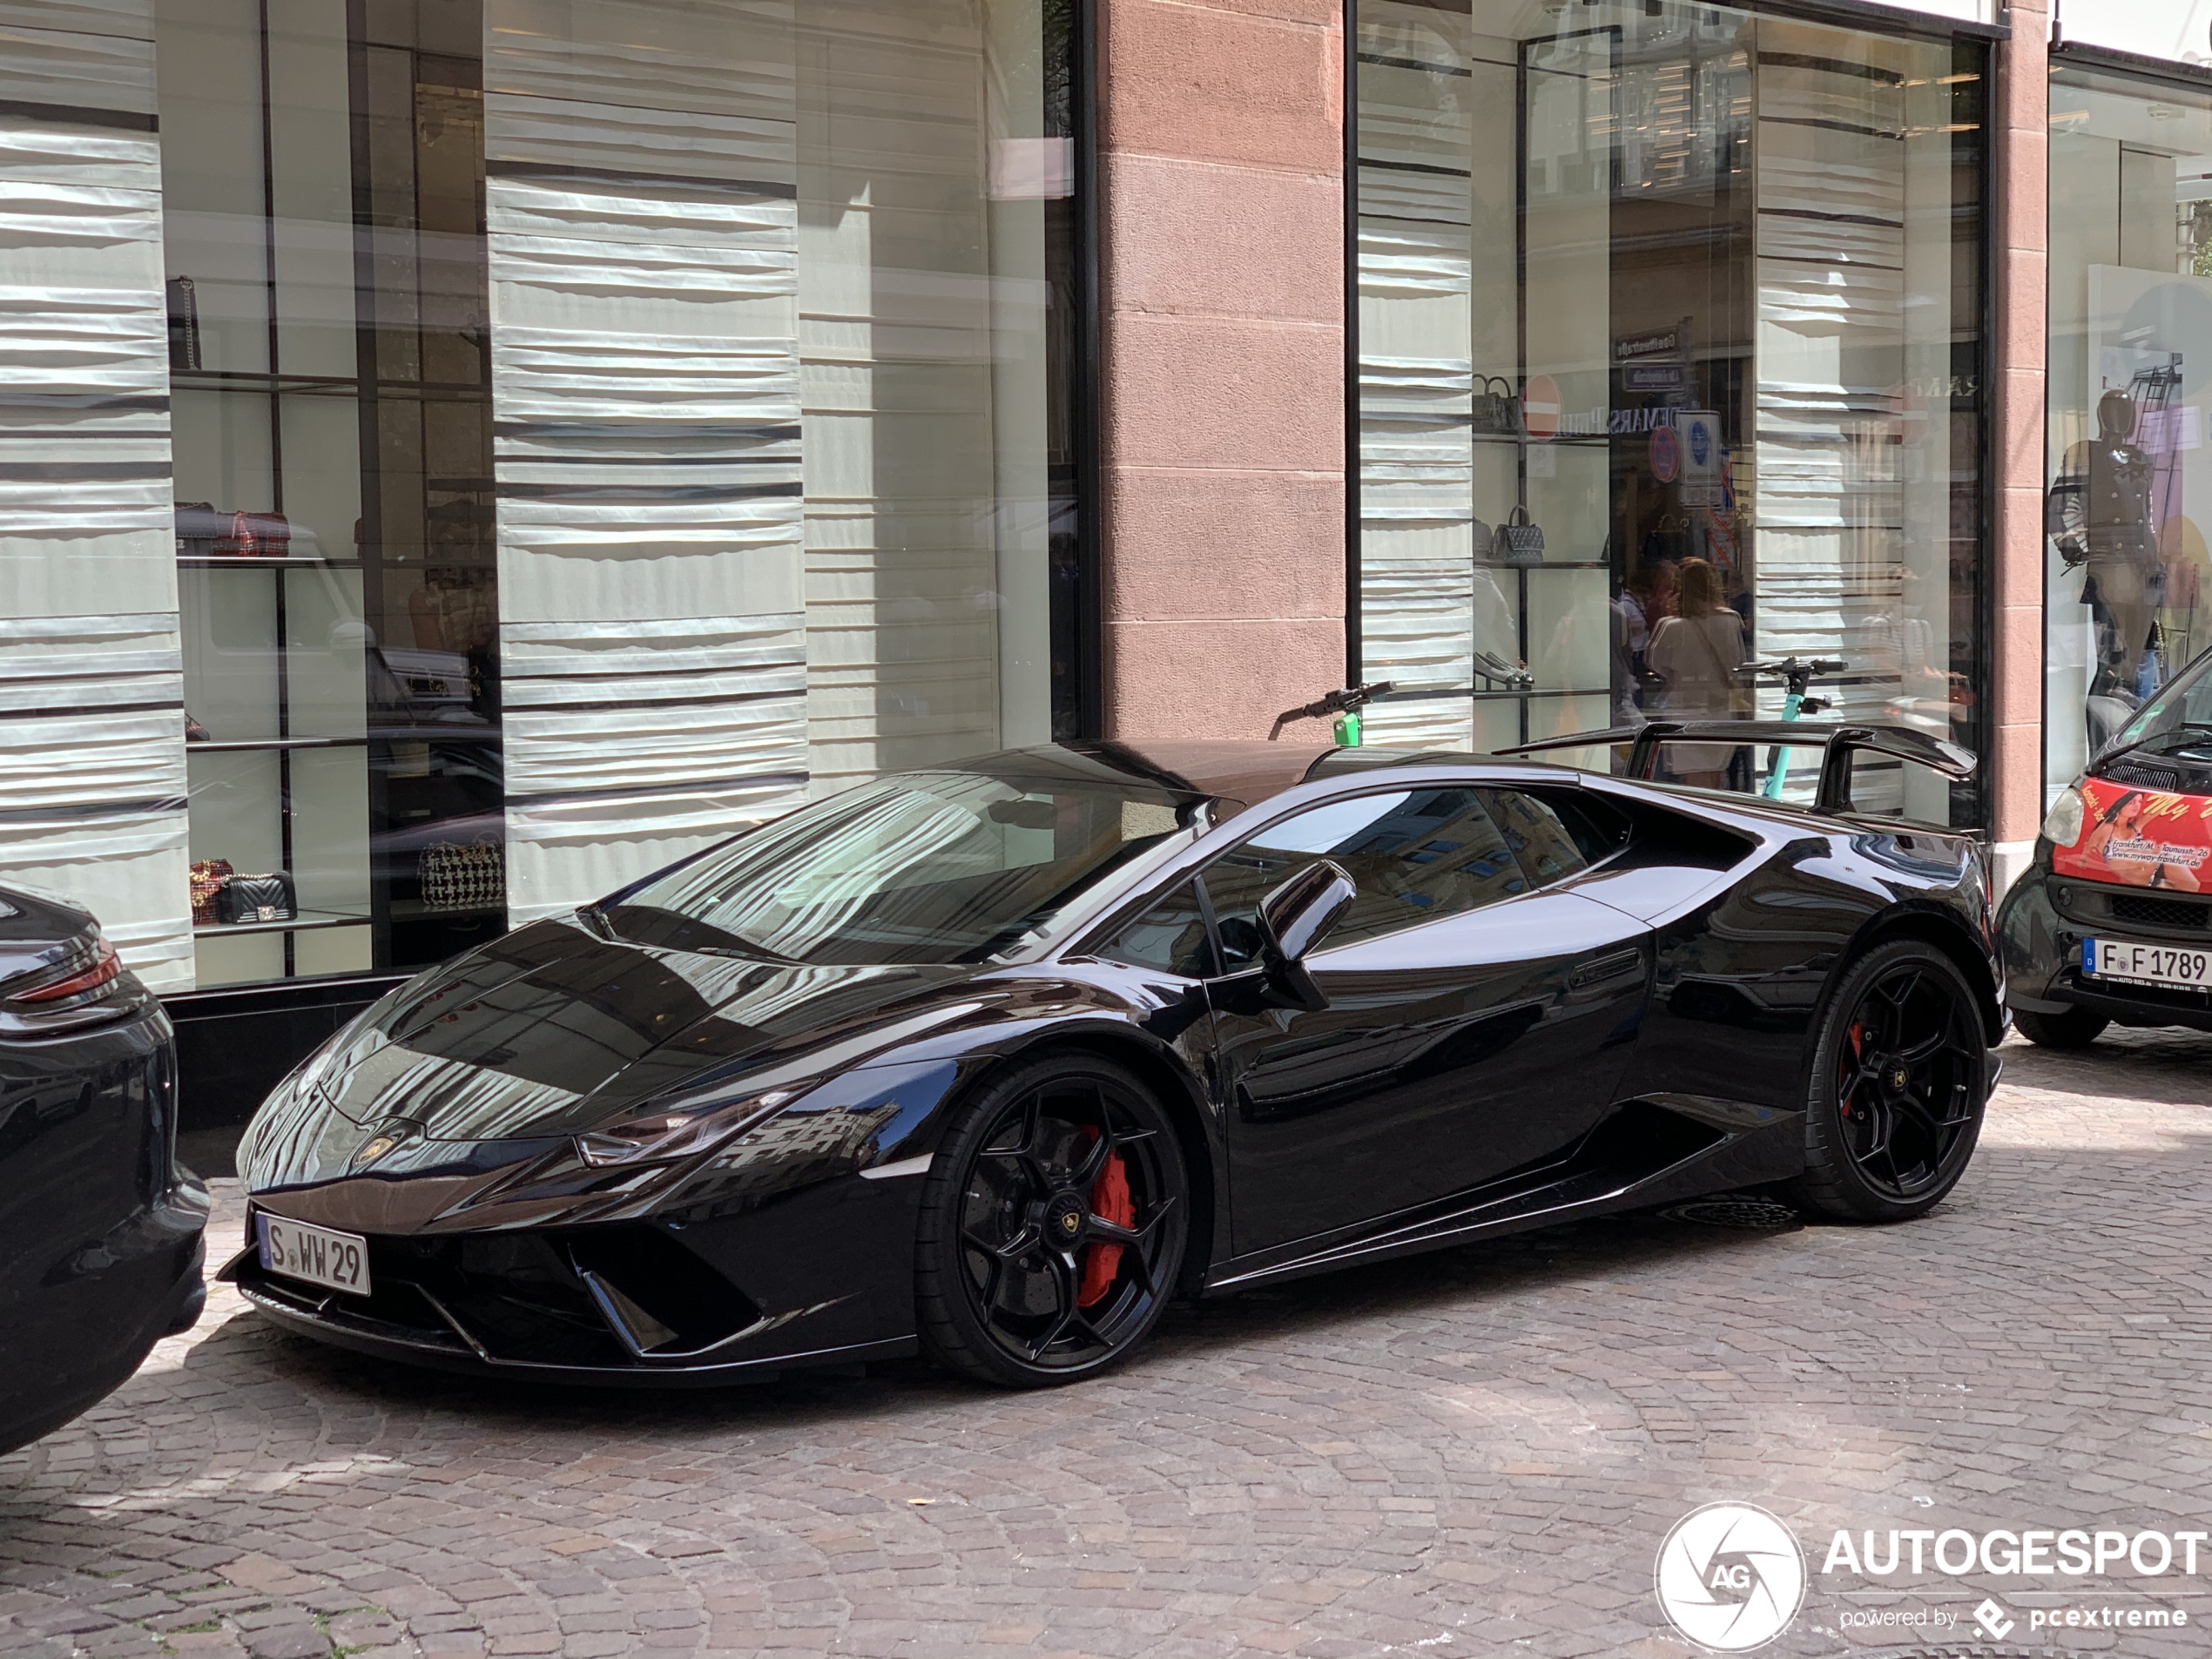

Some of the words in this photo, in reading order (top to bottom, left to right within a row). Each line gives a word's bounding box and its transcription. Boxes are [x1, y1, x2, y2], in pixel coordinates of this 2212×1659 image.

[2142, 793, 2190, 822] My
[2112, 840, 2155, 851] Frankfurt/M.
[2161, 844, 2195, 855] Taunusstr.
[2197, 849, 2209, 858] 26
[2104, 945, 2117, 969] F
[2133, 948, 2146, 973] F
[2151, 950, 2207, 981] 1789
[270, 1224, 285, 1265] S
[298, 1231, 327, 1278] WW
[331, 1240, 360, 1286] 29
